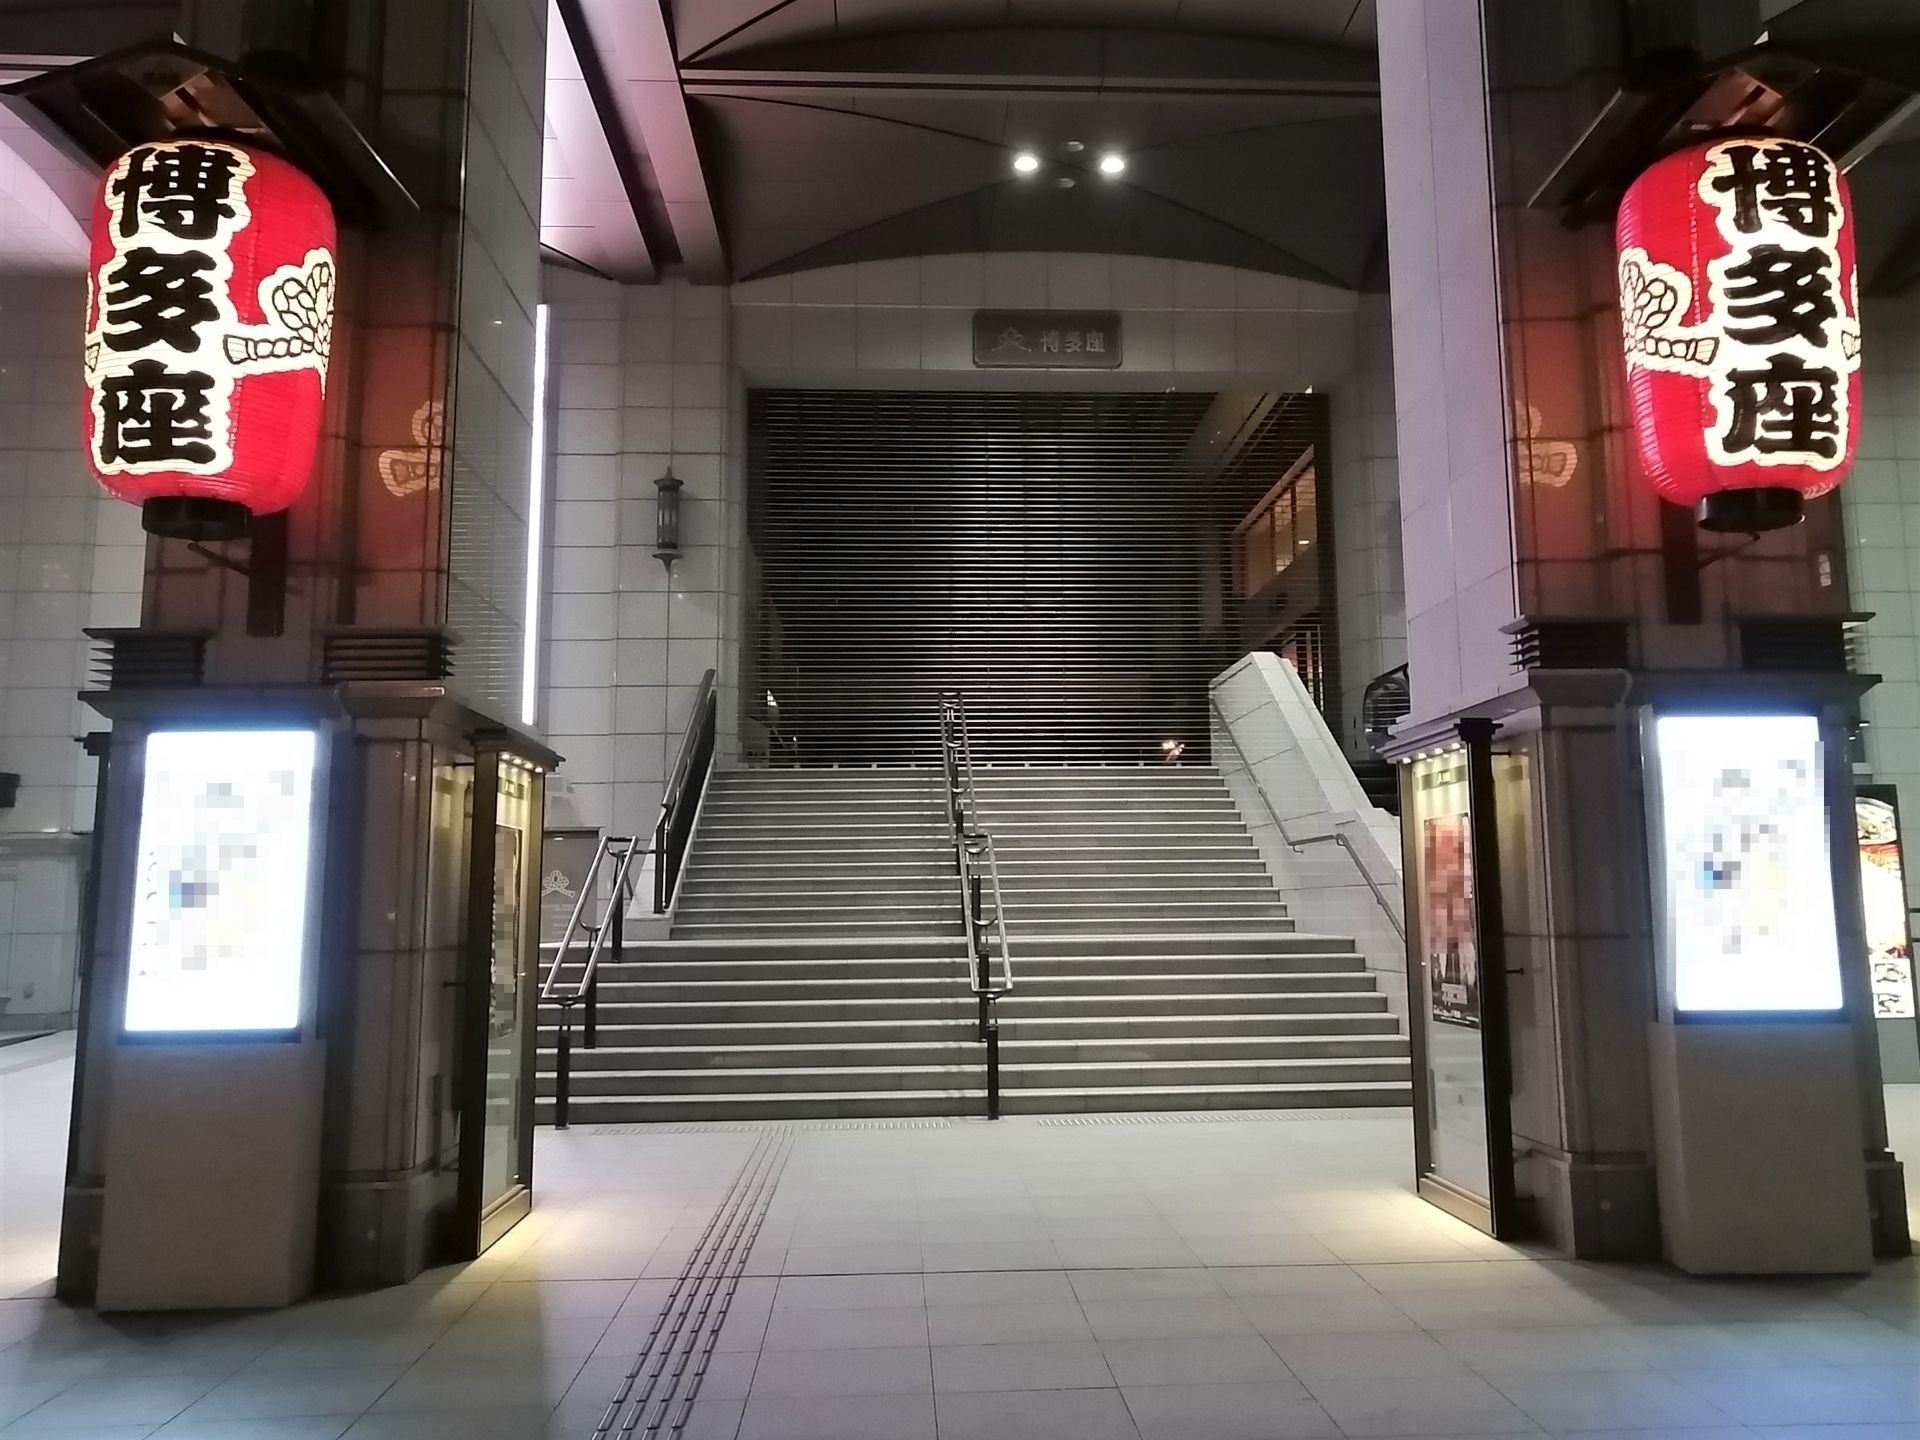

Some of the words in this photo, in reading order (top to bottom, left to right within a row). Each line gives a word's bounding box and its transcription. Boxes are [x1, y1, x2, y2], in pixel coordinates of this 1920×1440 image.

[100, 144, 241, 465] 博多座
[1040, 330, 1106, 353] 博多座
[1711, 146, 1839, 457] 博多座
